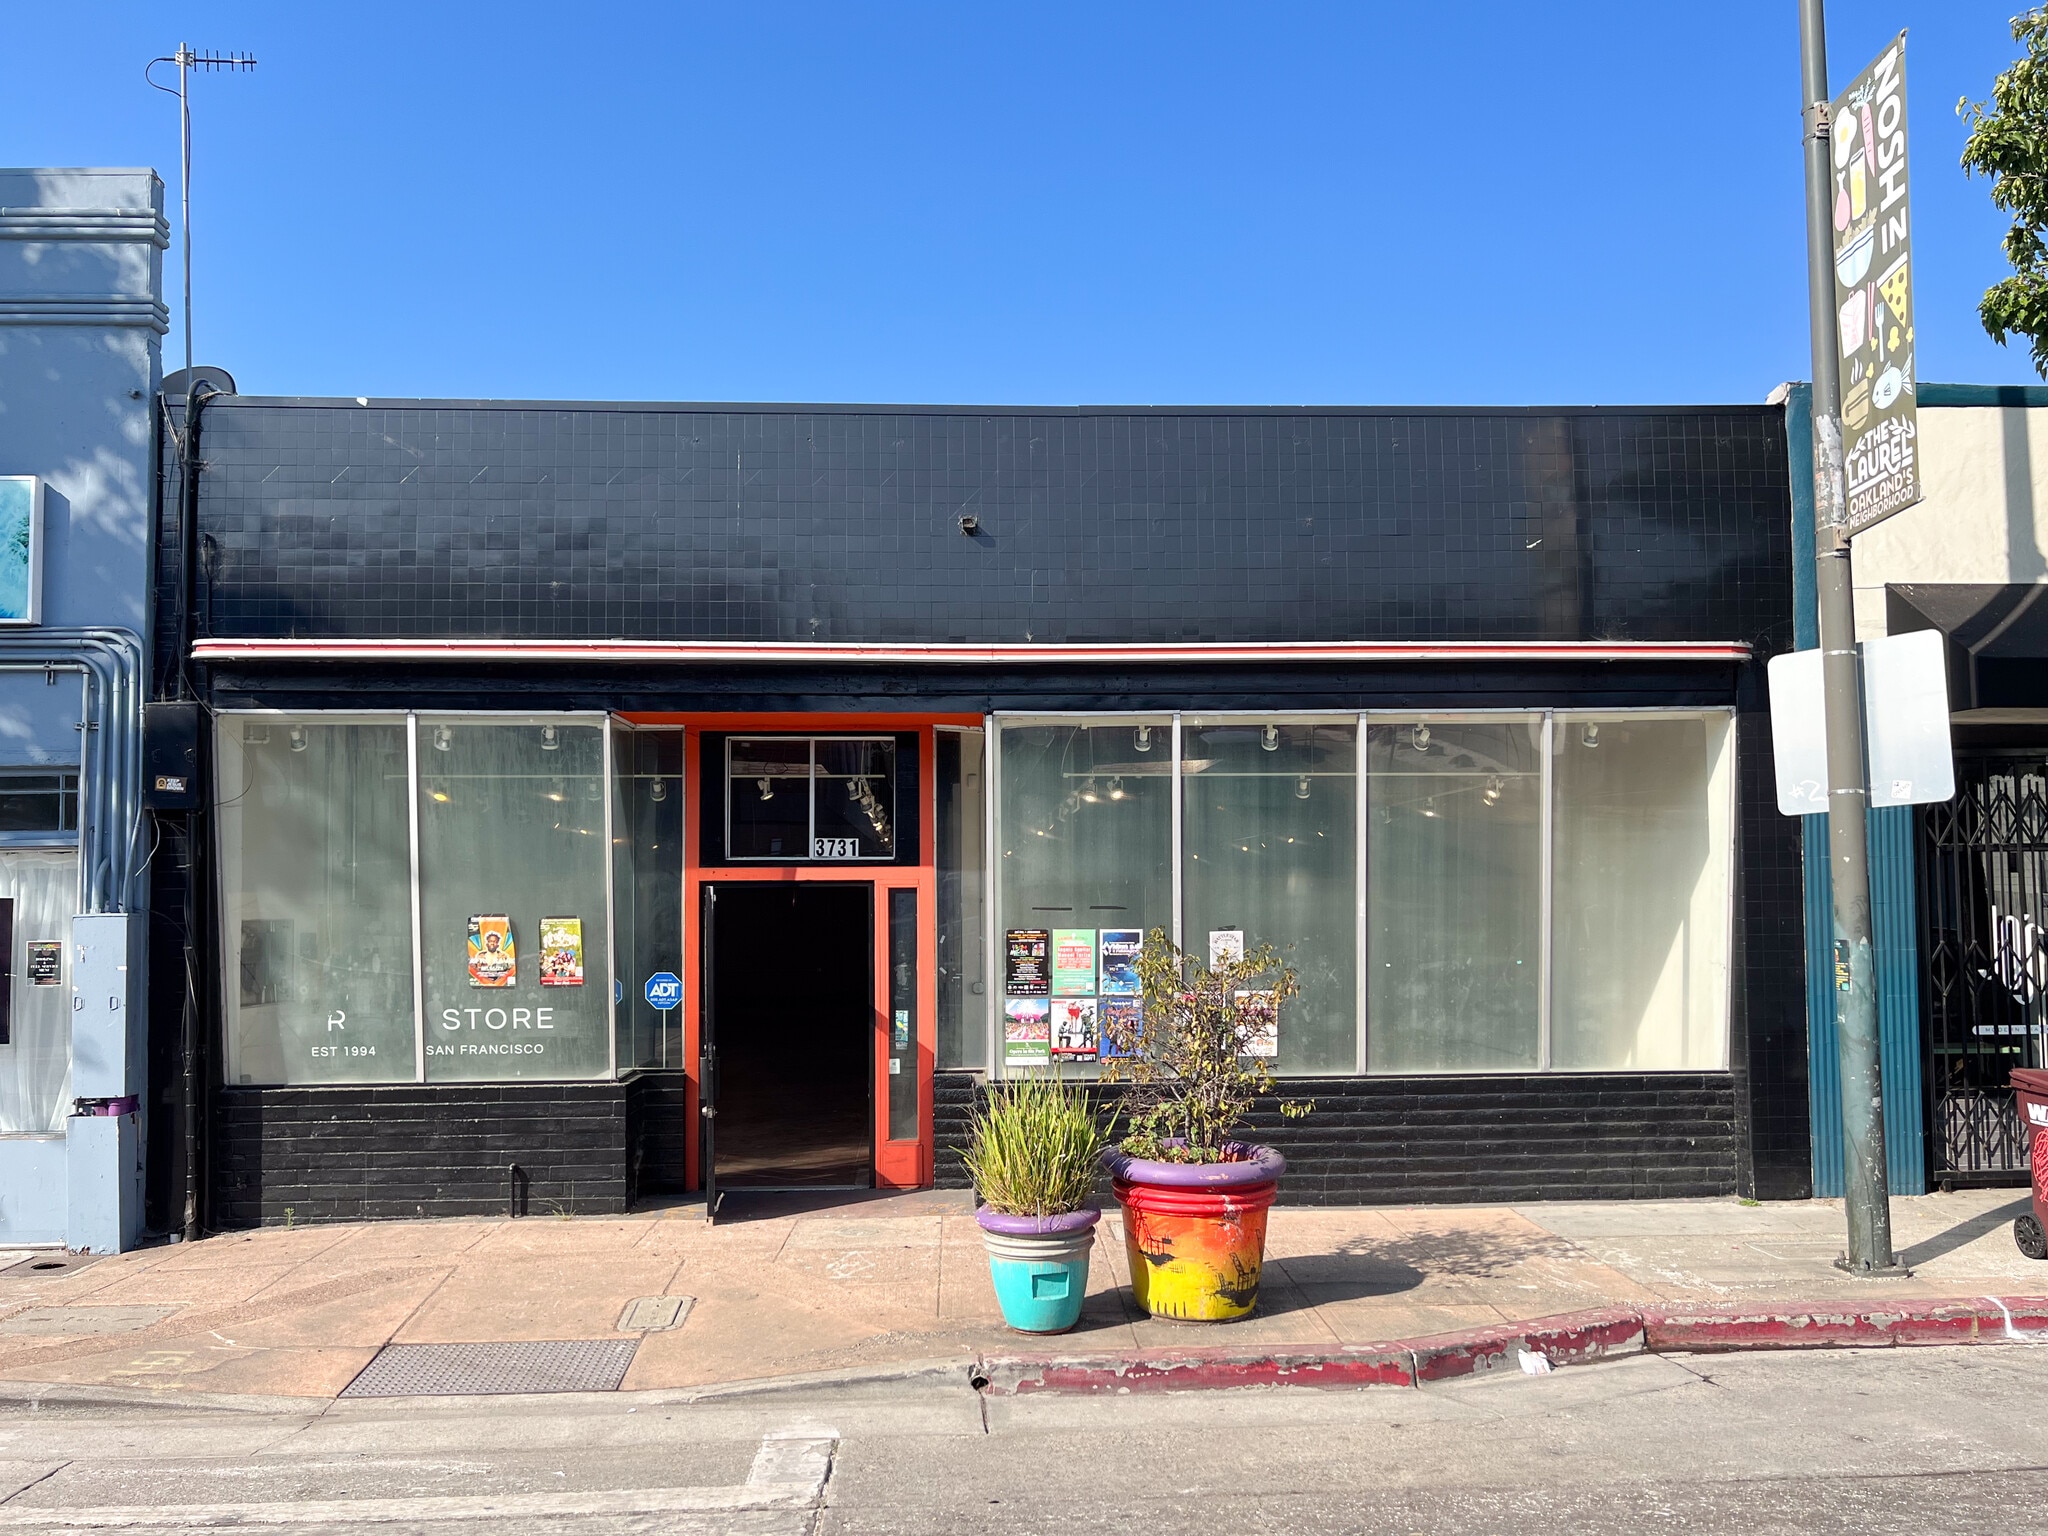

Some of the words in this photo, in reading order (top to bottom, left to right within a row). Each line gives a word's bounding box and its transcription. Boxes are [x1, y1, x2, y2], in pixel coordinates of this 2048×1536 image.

[1874, 45, 1905, 212] NOSH
[1881, 206, 1907, 255] IN
[1864, 419, 1889, 450] THE
[1848, 431, 1913, 490] LAUREL
[1849, 467, 1914, 514] OAKLAND'S
[1849, 485, 1914, 530] NEIGHBORHOOD
[815, 838, 857, 857] 3731
[649, 982, 679, 997] ADT
[327, 1009, 346, 1032] R
[442, 1007, 554, 1031] STORE
[311, 1046, 338, 1057] EST
[343, 1046, 377, 1057] 1994
[425, 1044, 455, 1056] SAN
[460, 1043, 545, 1055] FRANCISCO
